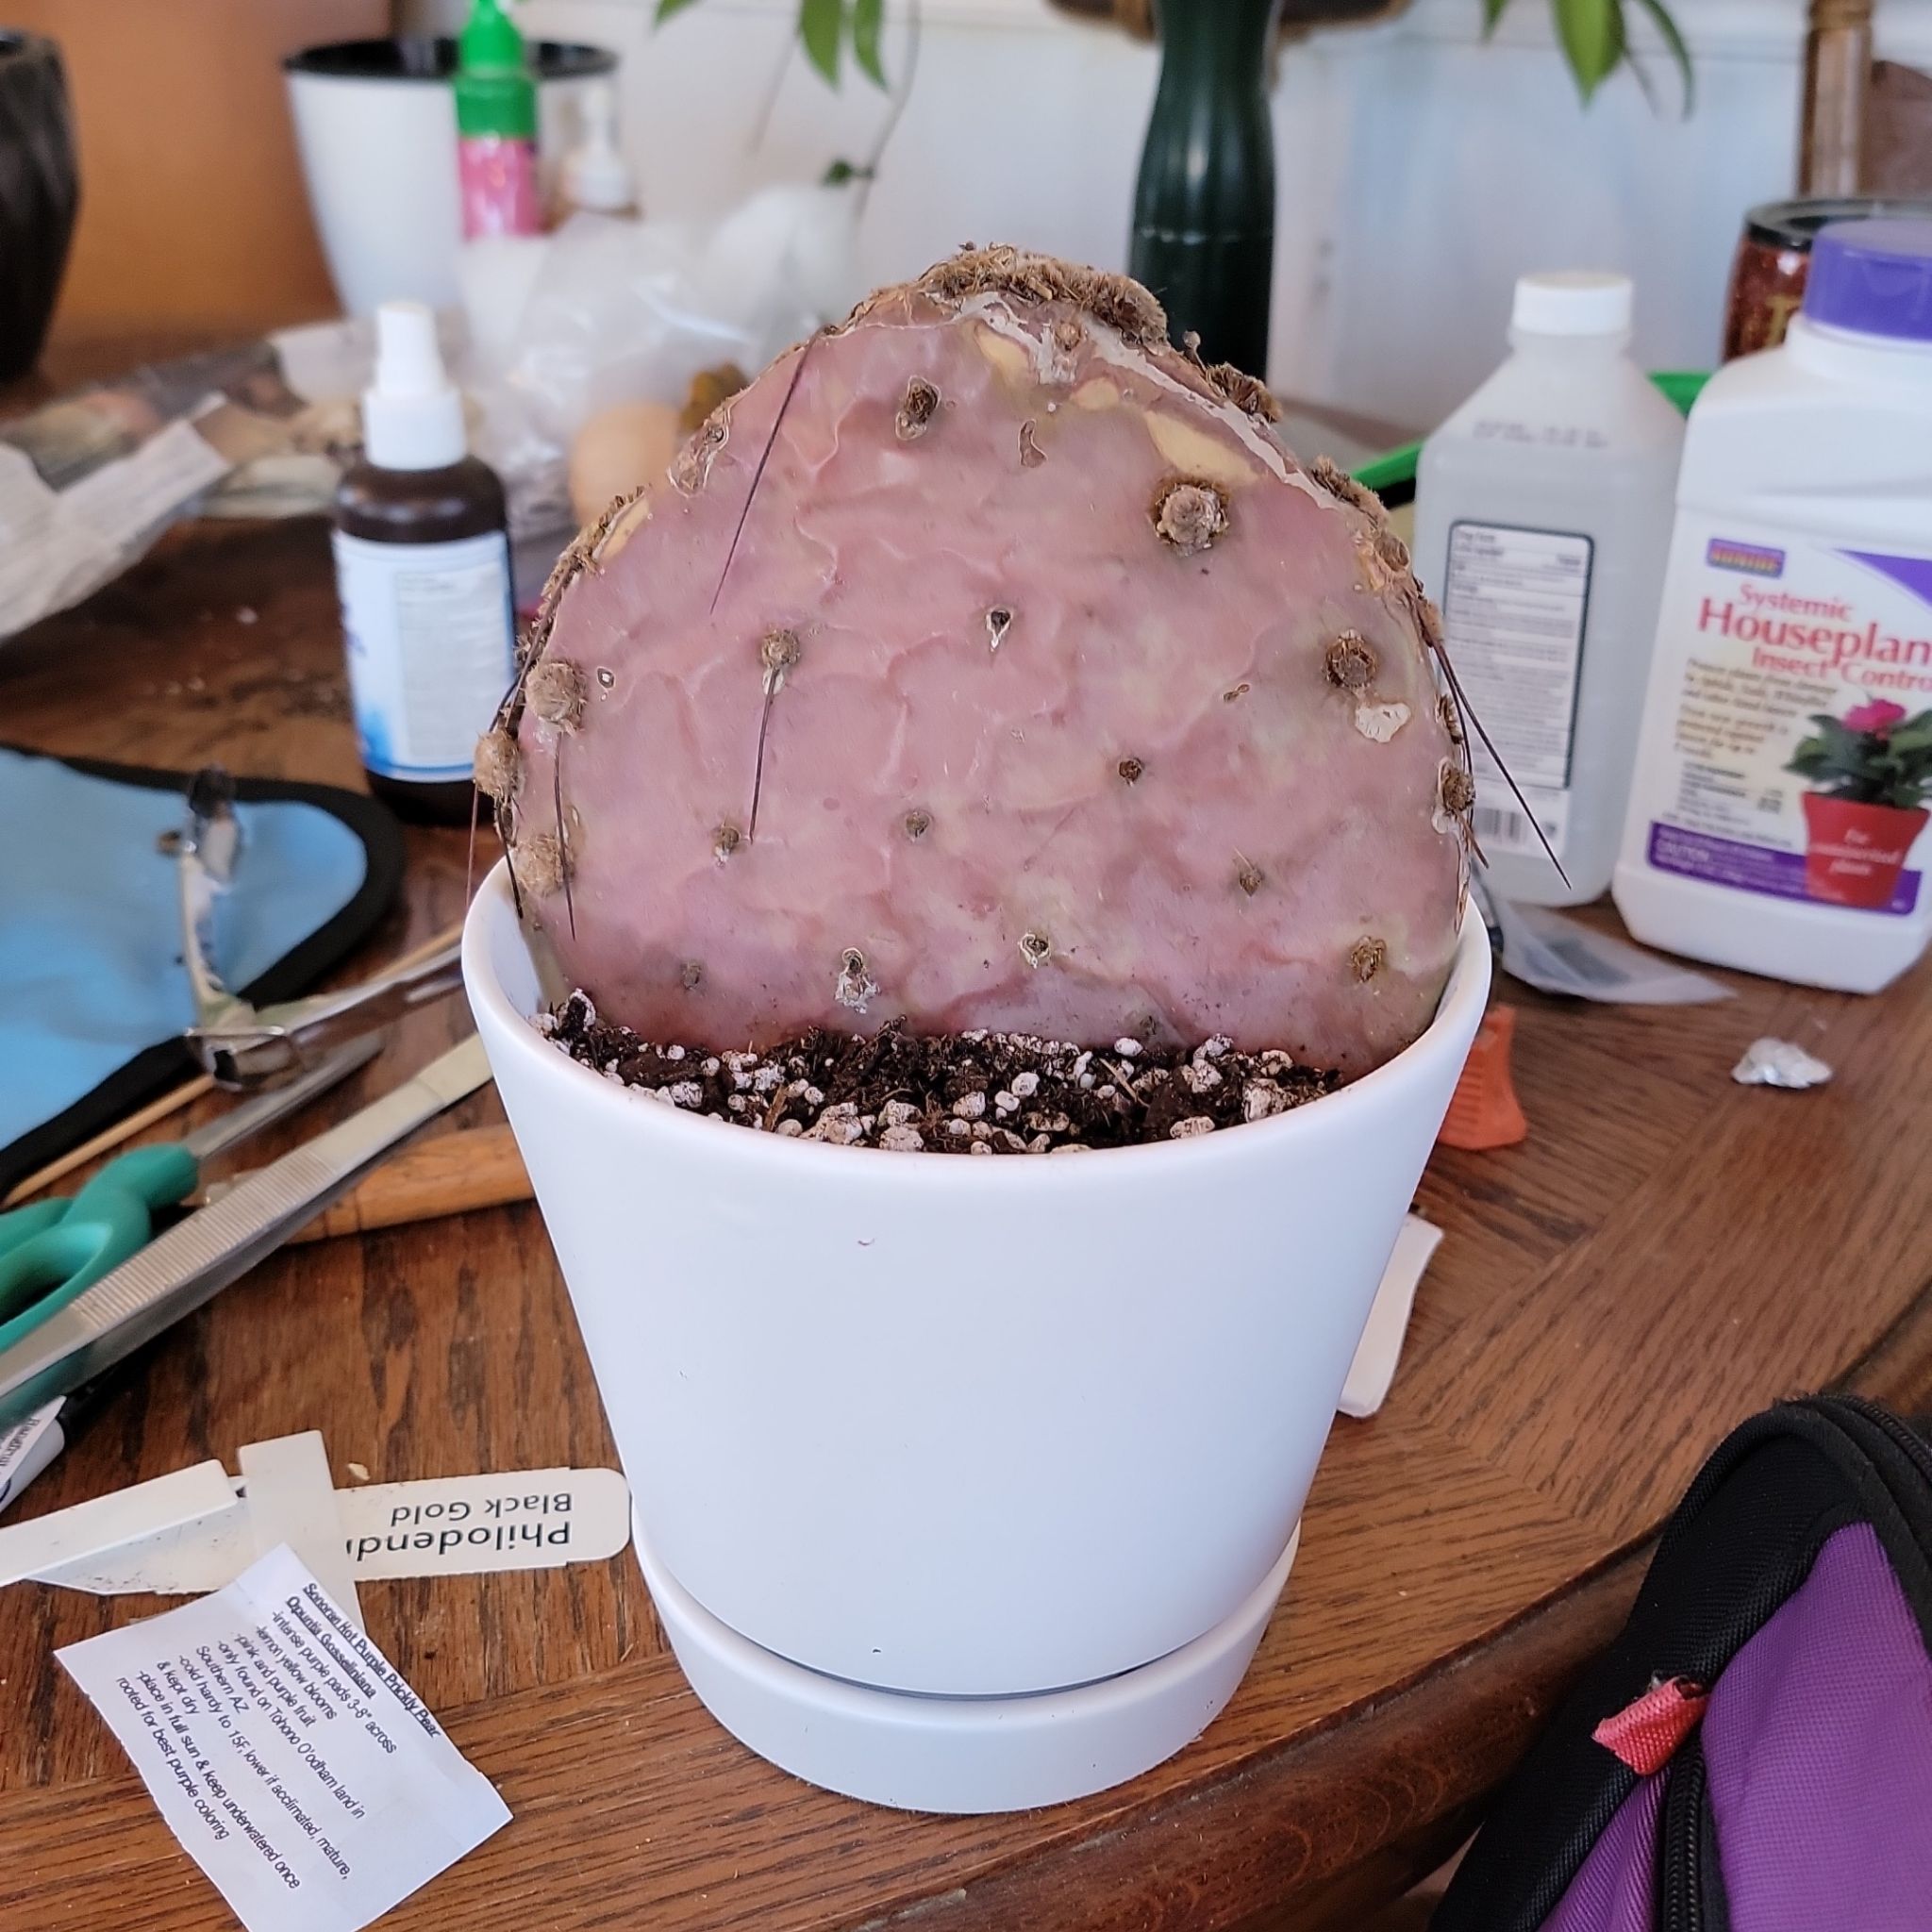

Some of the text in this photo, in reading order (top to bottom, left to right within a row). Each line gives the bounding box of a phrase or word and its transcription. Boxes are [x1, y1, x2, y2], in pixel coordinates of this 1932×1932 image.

[1698, 596, 1932, 667] Houseplan
[1740, 582, 1854, 622] Systemic
[1752, 646, 1828, 679] Insect
[390, 1492, 572, 1527] Black Gold
[157, 1661, 200, 1714] & kept dry
[196, 1645, 250, 1714] Southern AZ
[254, 1659, 276, 1679] and
[264, 1676, 298, 1707] purple
[275, 1654, 308, 1685] yellow
[303, 1681, 338, 1720] blooms
[297, 1646, 330, 1678] purple
[323, 1676, 352, 1702] pads
[365, 1721, 397, 1754] across
[350, 1638, 387, 1678] Purple
[380, 1672, 418, 1714] Prickly
[412, 1707, 441, 1739] Pear
[234, 1666, 265, 1698] found
[257, 1696, 273, 1711] on
[269, 1707, 301, 1745] Tohono
[332, 1785, 359, 1809] land
[351, 1806, 365, 1819] in
[292, 1705, 317, 1728] fruit
[116, 1677, 230, 1840] rooted for best purple coloring
[136, 1671, 300, 1889] -place in full sun & keep underwatered once
[179, 1656, 205, 1681] -cold
[195, 1680, 224, 1713] hardy
[218, 1714, 232, 1728] to
[243, 1749, 271, 1777] lower
[264, 1774, 280, 1786] if
[316, 1838, 350, 1880] mature,
